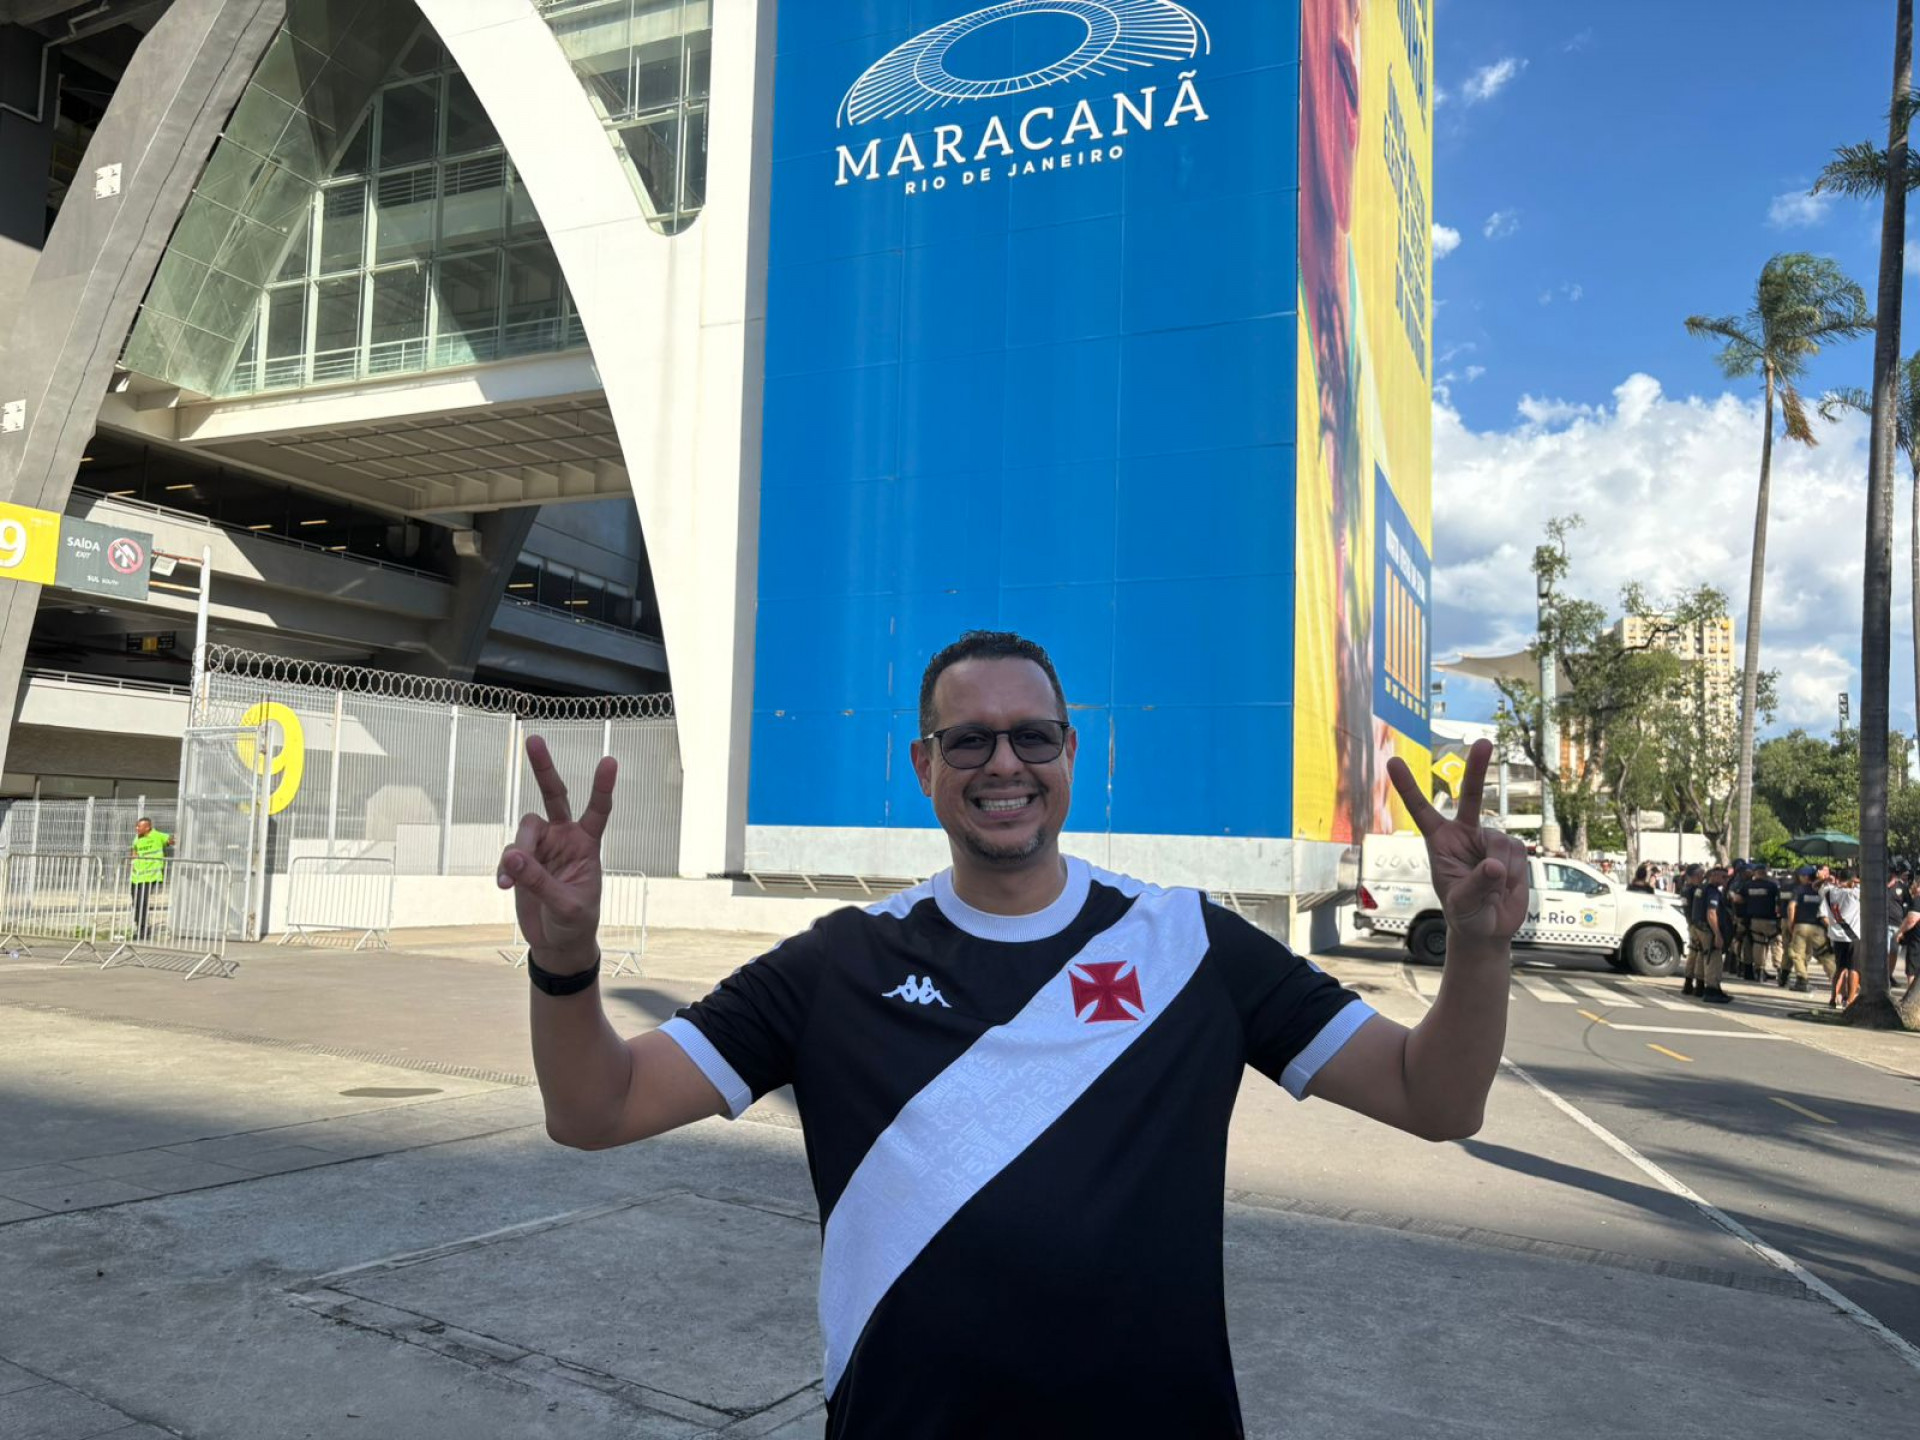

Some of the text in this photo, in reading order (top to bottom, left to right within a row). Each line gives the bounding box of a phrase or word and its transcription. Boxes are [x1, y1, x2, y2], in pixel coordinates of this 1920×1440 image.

[834, 69, 1209, 186] MARACANÃ
[905, 146, 1124, 194] RIO DE JANEIRO
[0, 518, 26, 568] 9
[67, 536, 101, 552] SAÍDA
[237, 702, 304, 815] 9
